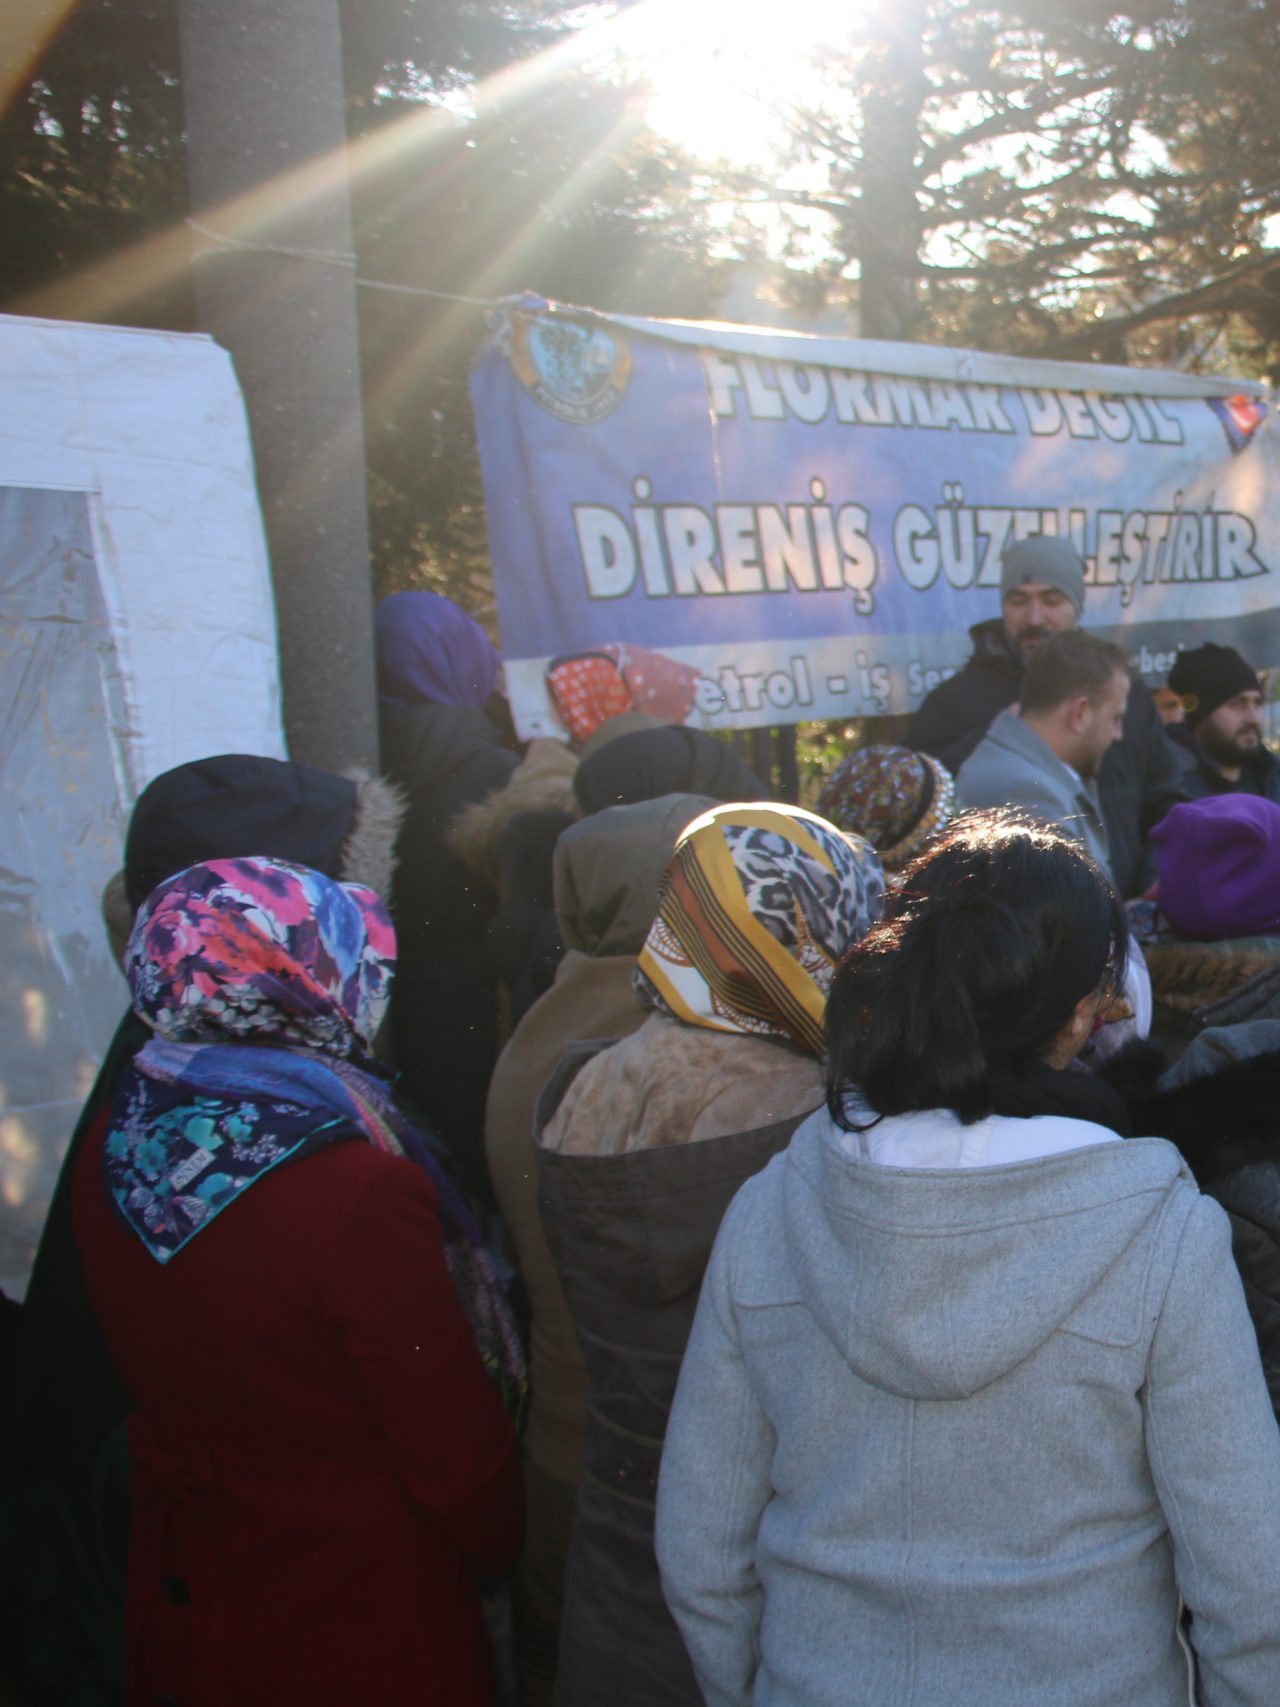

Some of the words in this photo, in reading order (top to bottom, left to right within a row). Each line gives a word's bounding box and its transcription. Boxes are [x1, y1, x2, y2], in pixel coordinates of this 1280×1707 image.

[571, 475, 878, 616] DİRENİŞ
[893, 480, 1271, 607] GÜZLEŞTİRİR
[694, 655, 813, 715] etrol
